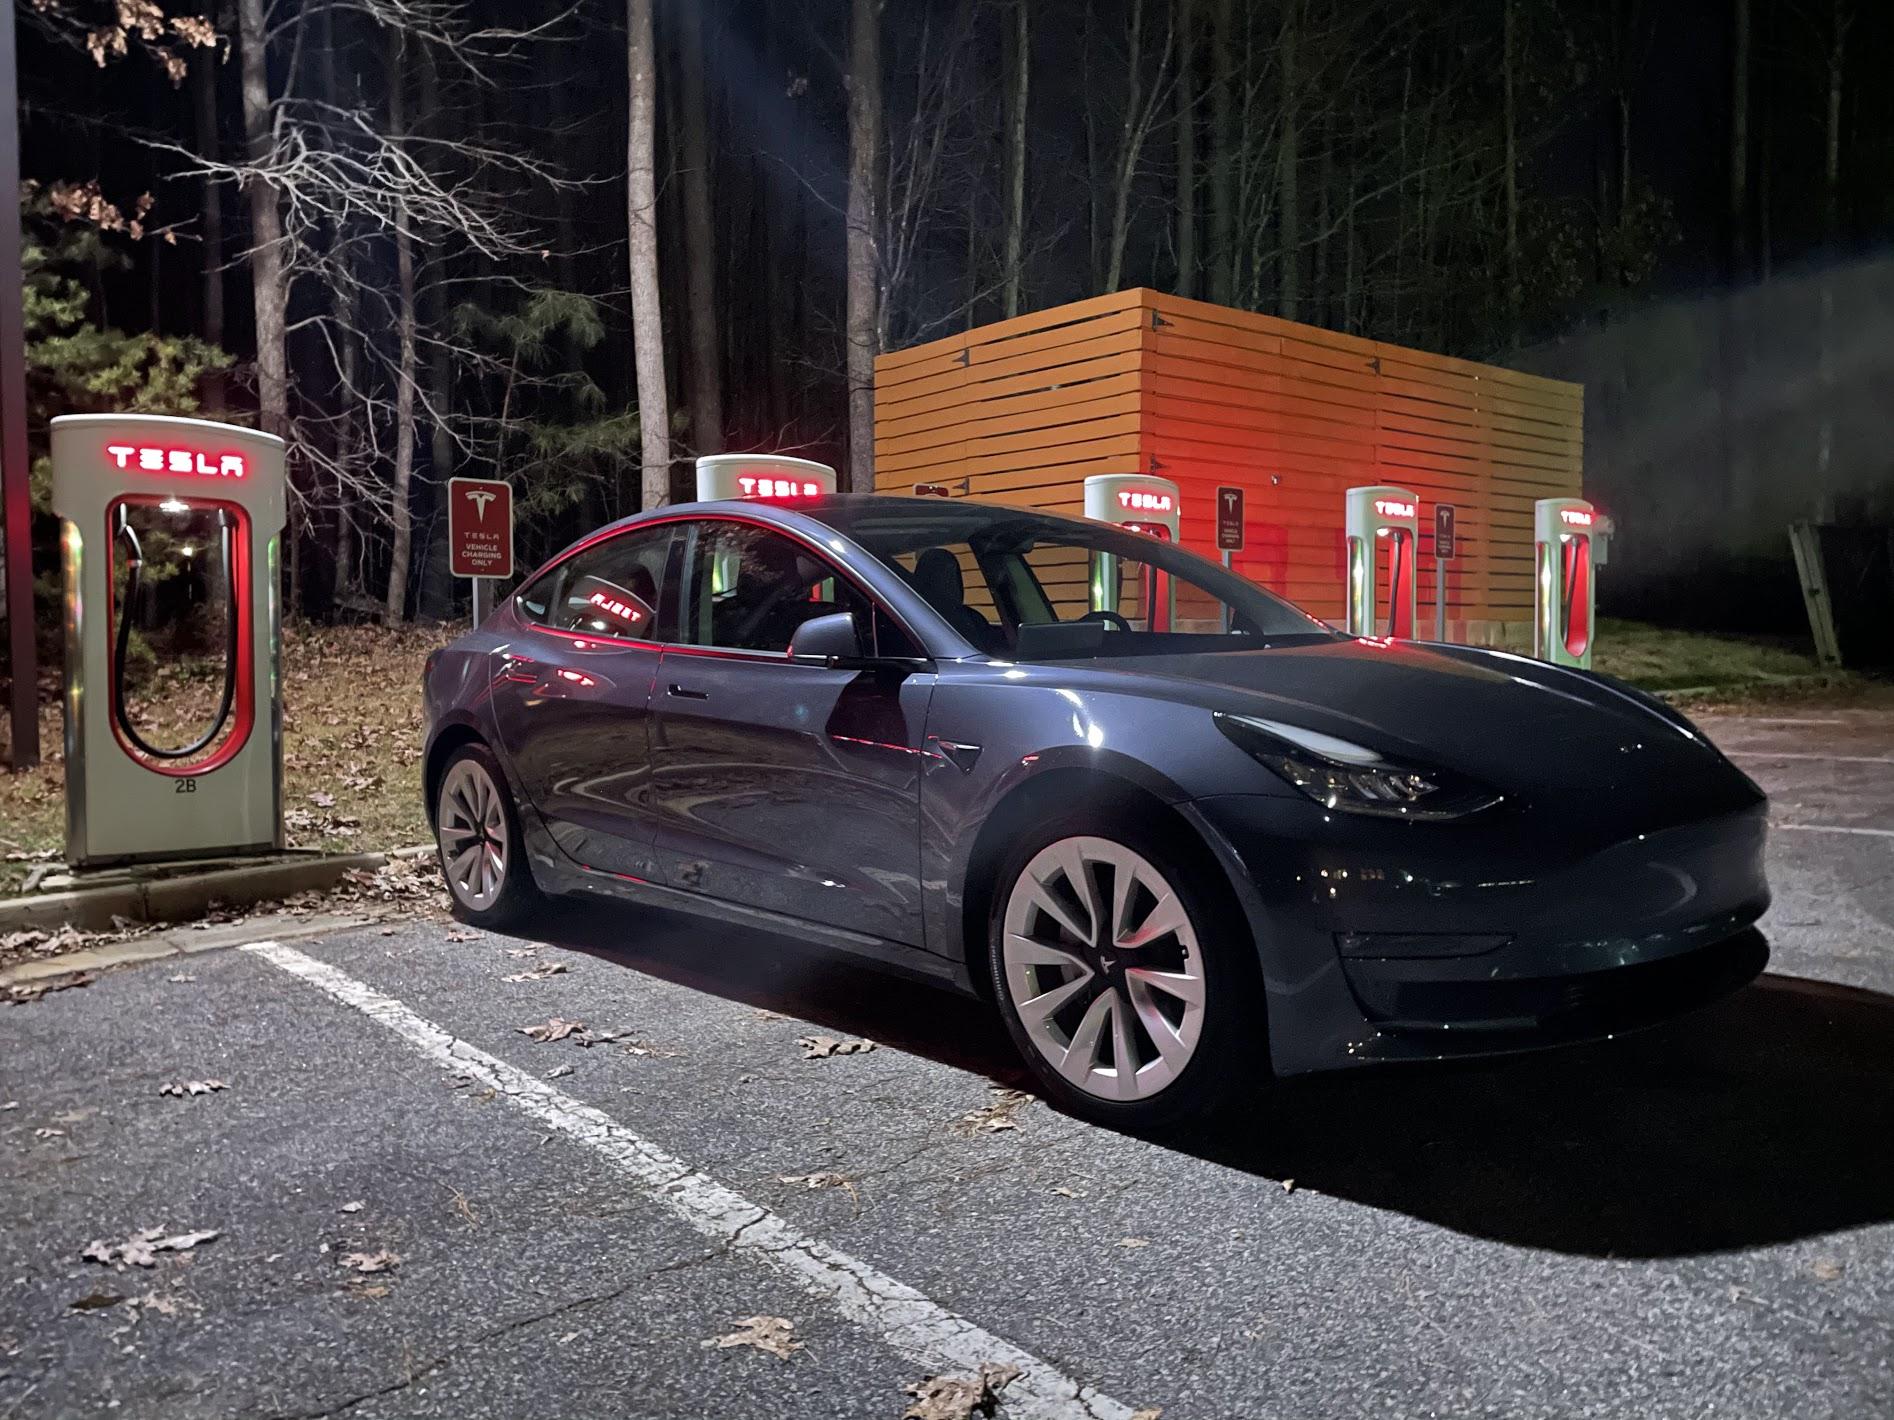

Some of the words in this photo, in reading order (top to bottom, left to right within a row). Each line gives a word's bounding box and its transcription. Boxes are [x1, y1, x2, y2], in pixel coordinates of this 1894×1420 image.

[107, 446, 244, 477] TESLA
[738, 477, 818, 497] TESLA
[1118, 492, 1171, 511] TESLA
[464, 532, 500, 541] TESLA
[466, 543, 498, 552] VEHICLE
[462, 550, 502, 560] CHARGING
[471, 558, 493, 567] ONLY
[174, 778, 197, 794] 2B
